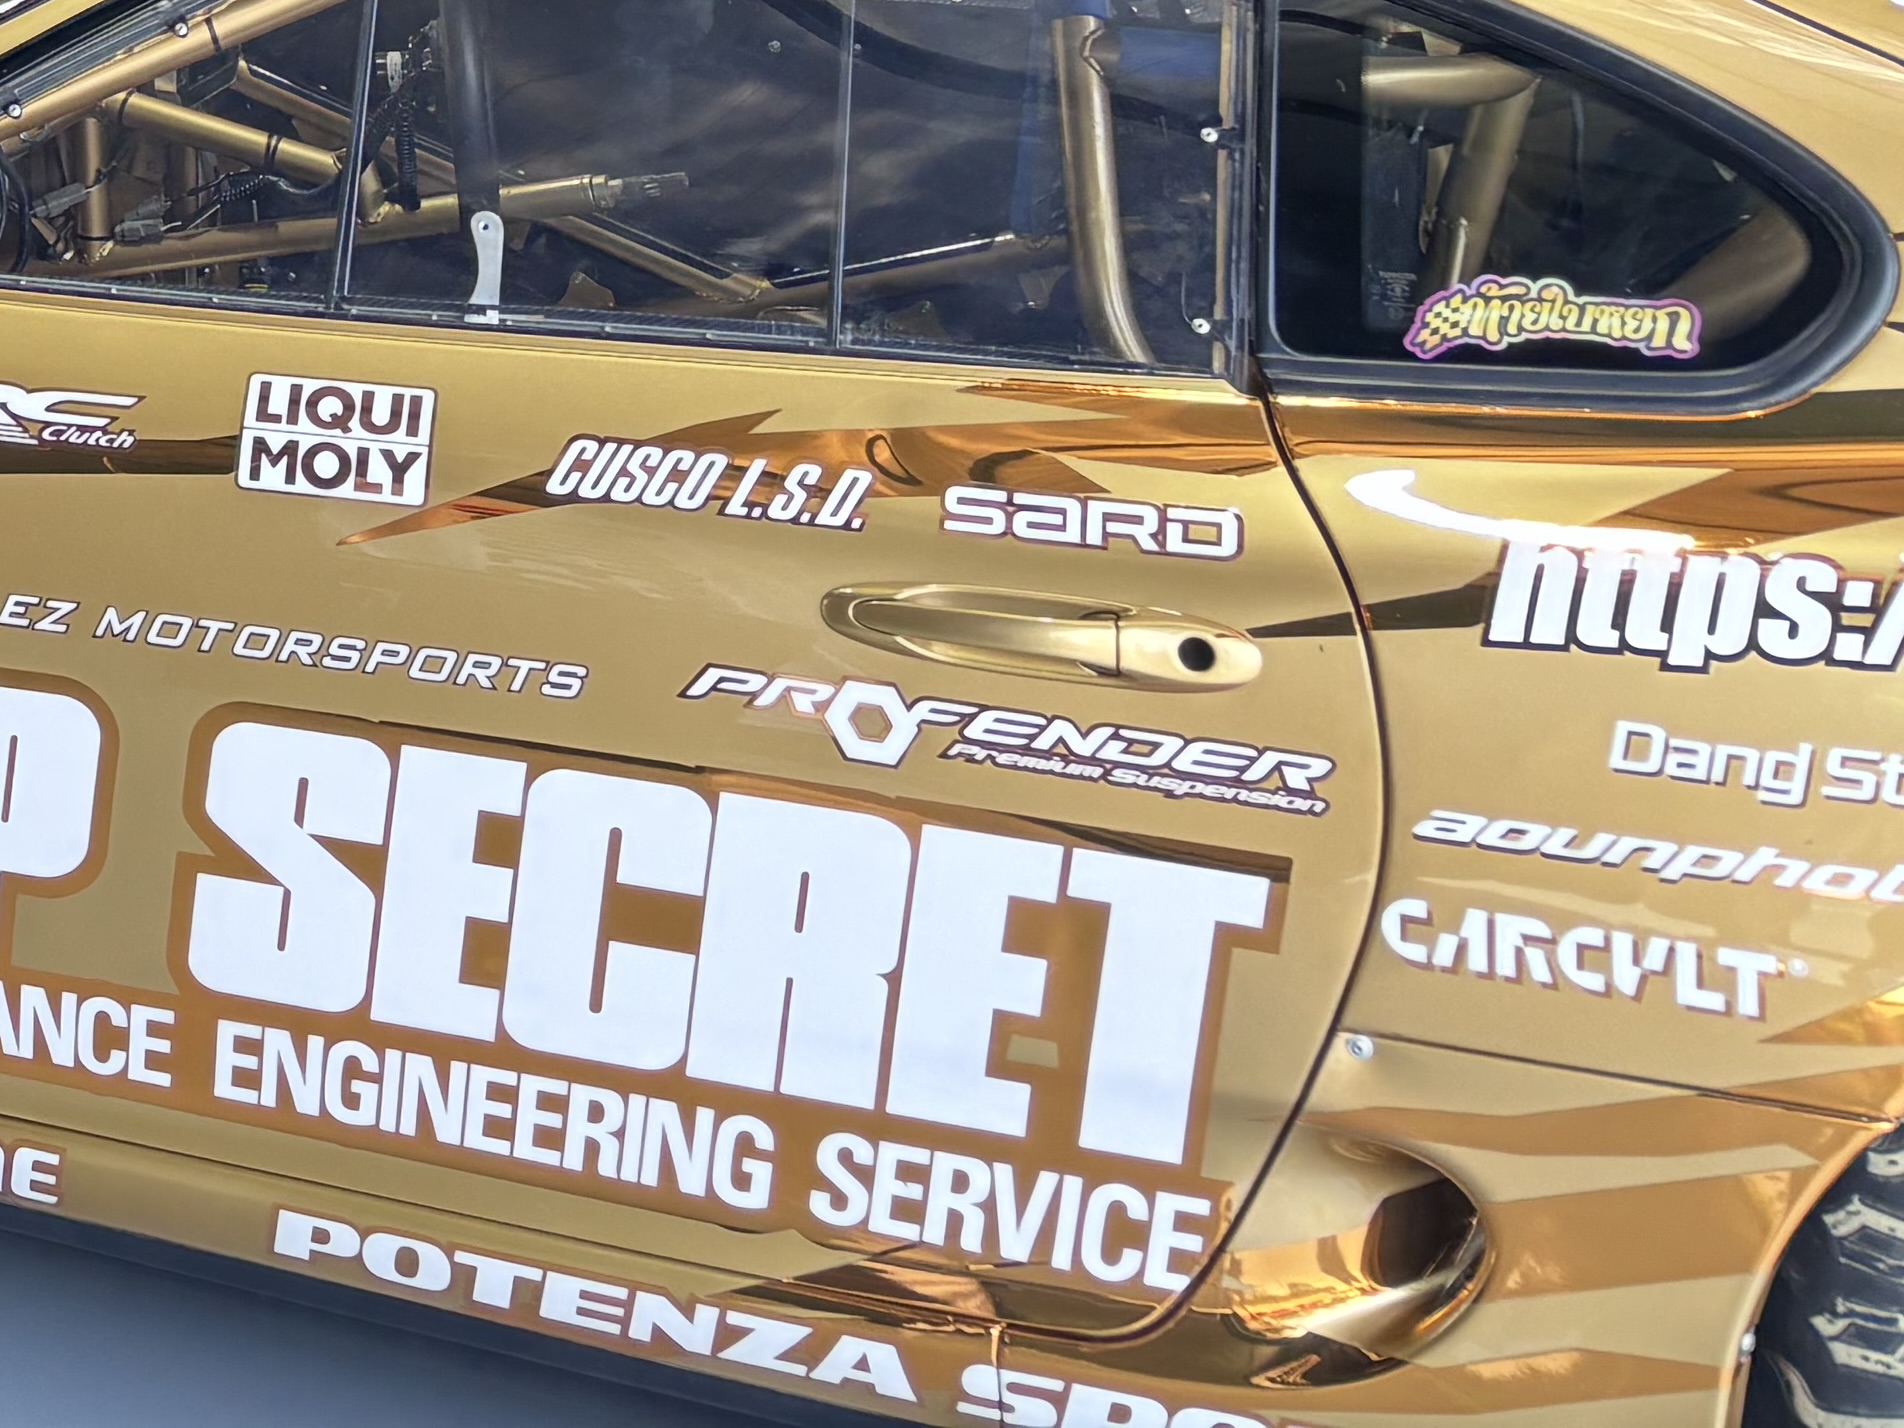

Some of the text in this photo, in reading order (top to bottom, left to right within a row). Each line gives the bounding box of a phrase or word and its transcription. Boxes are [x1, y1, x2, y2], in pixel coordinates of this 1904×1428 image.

[40, 423, 137, 451] Clutch
[256, 380, 425, 440] LIQUI
[249, 435, 427, 499] MOLY
[545, 436, 878, 532] CUSCO L.S.D.
[942, 485, 1241, 561] SARD
[95, 605, 590, 701] MOTORSPORTS
[677, 662, 1338, 794] PROFENDER
[1609, 718, 1814, 808] Dang
[946, 742, 1330, 816] Premium Suspension
[187, 719, 1272, 1169] SECRET
[214, 1016, 776, 1212] ENGINEERING
[809, 1130, 1214, 1290] SERVICE
[272, 1207, 919, 1404] POTENZA
